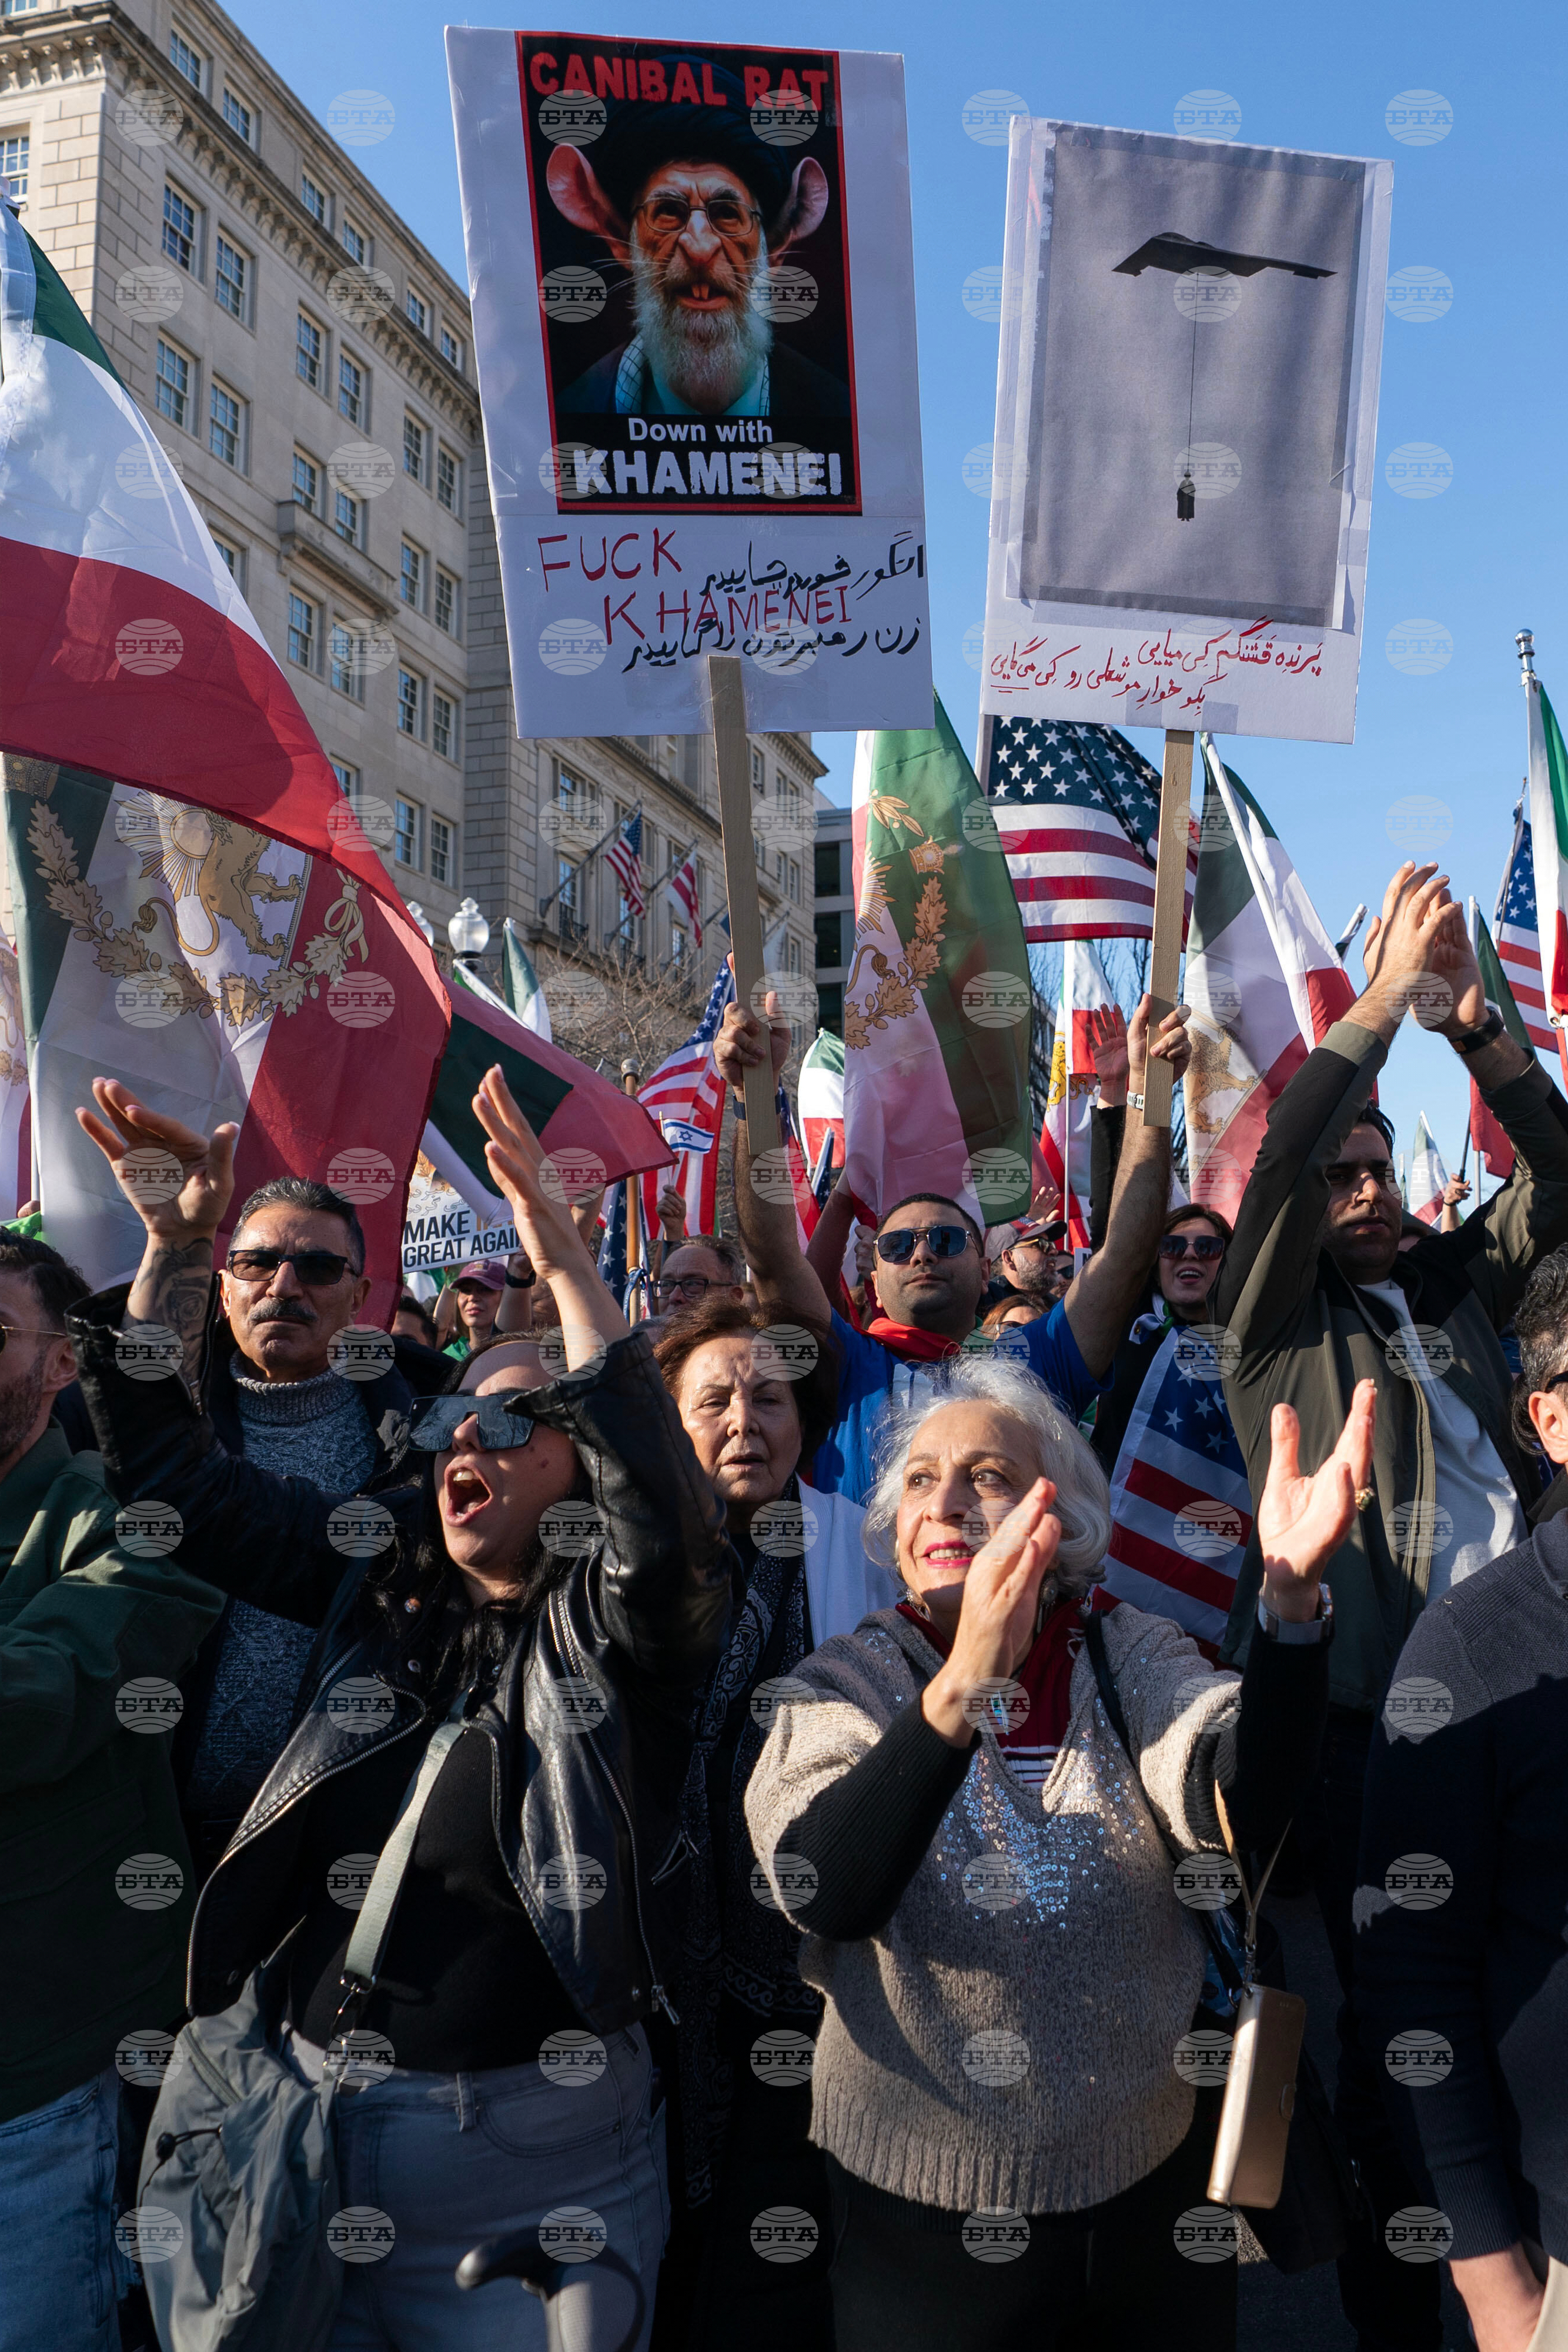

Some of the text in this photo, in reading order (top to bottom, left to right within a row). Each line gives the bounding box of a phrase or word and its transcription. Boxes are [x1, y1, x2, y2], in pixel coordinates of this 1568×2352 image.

[530, 52, 828, 111] CANIBAL RAT
[628, 417, 773, 442] Down with
[573, 449, 842, 496] KHAMENEI
[537, 527, 682, 592] FUCK
[603, 585, 852, 645] KHAMENEI
[404, 1210, 470, 1245] MAKE
[404, 1237, 466, 1268] GREAT
